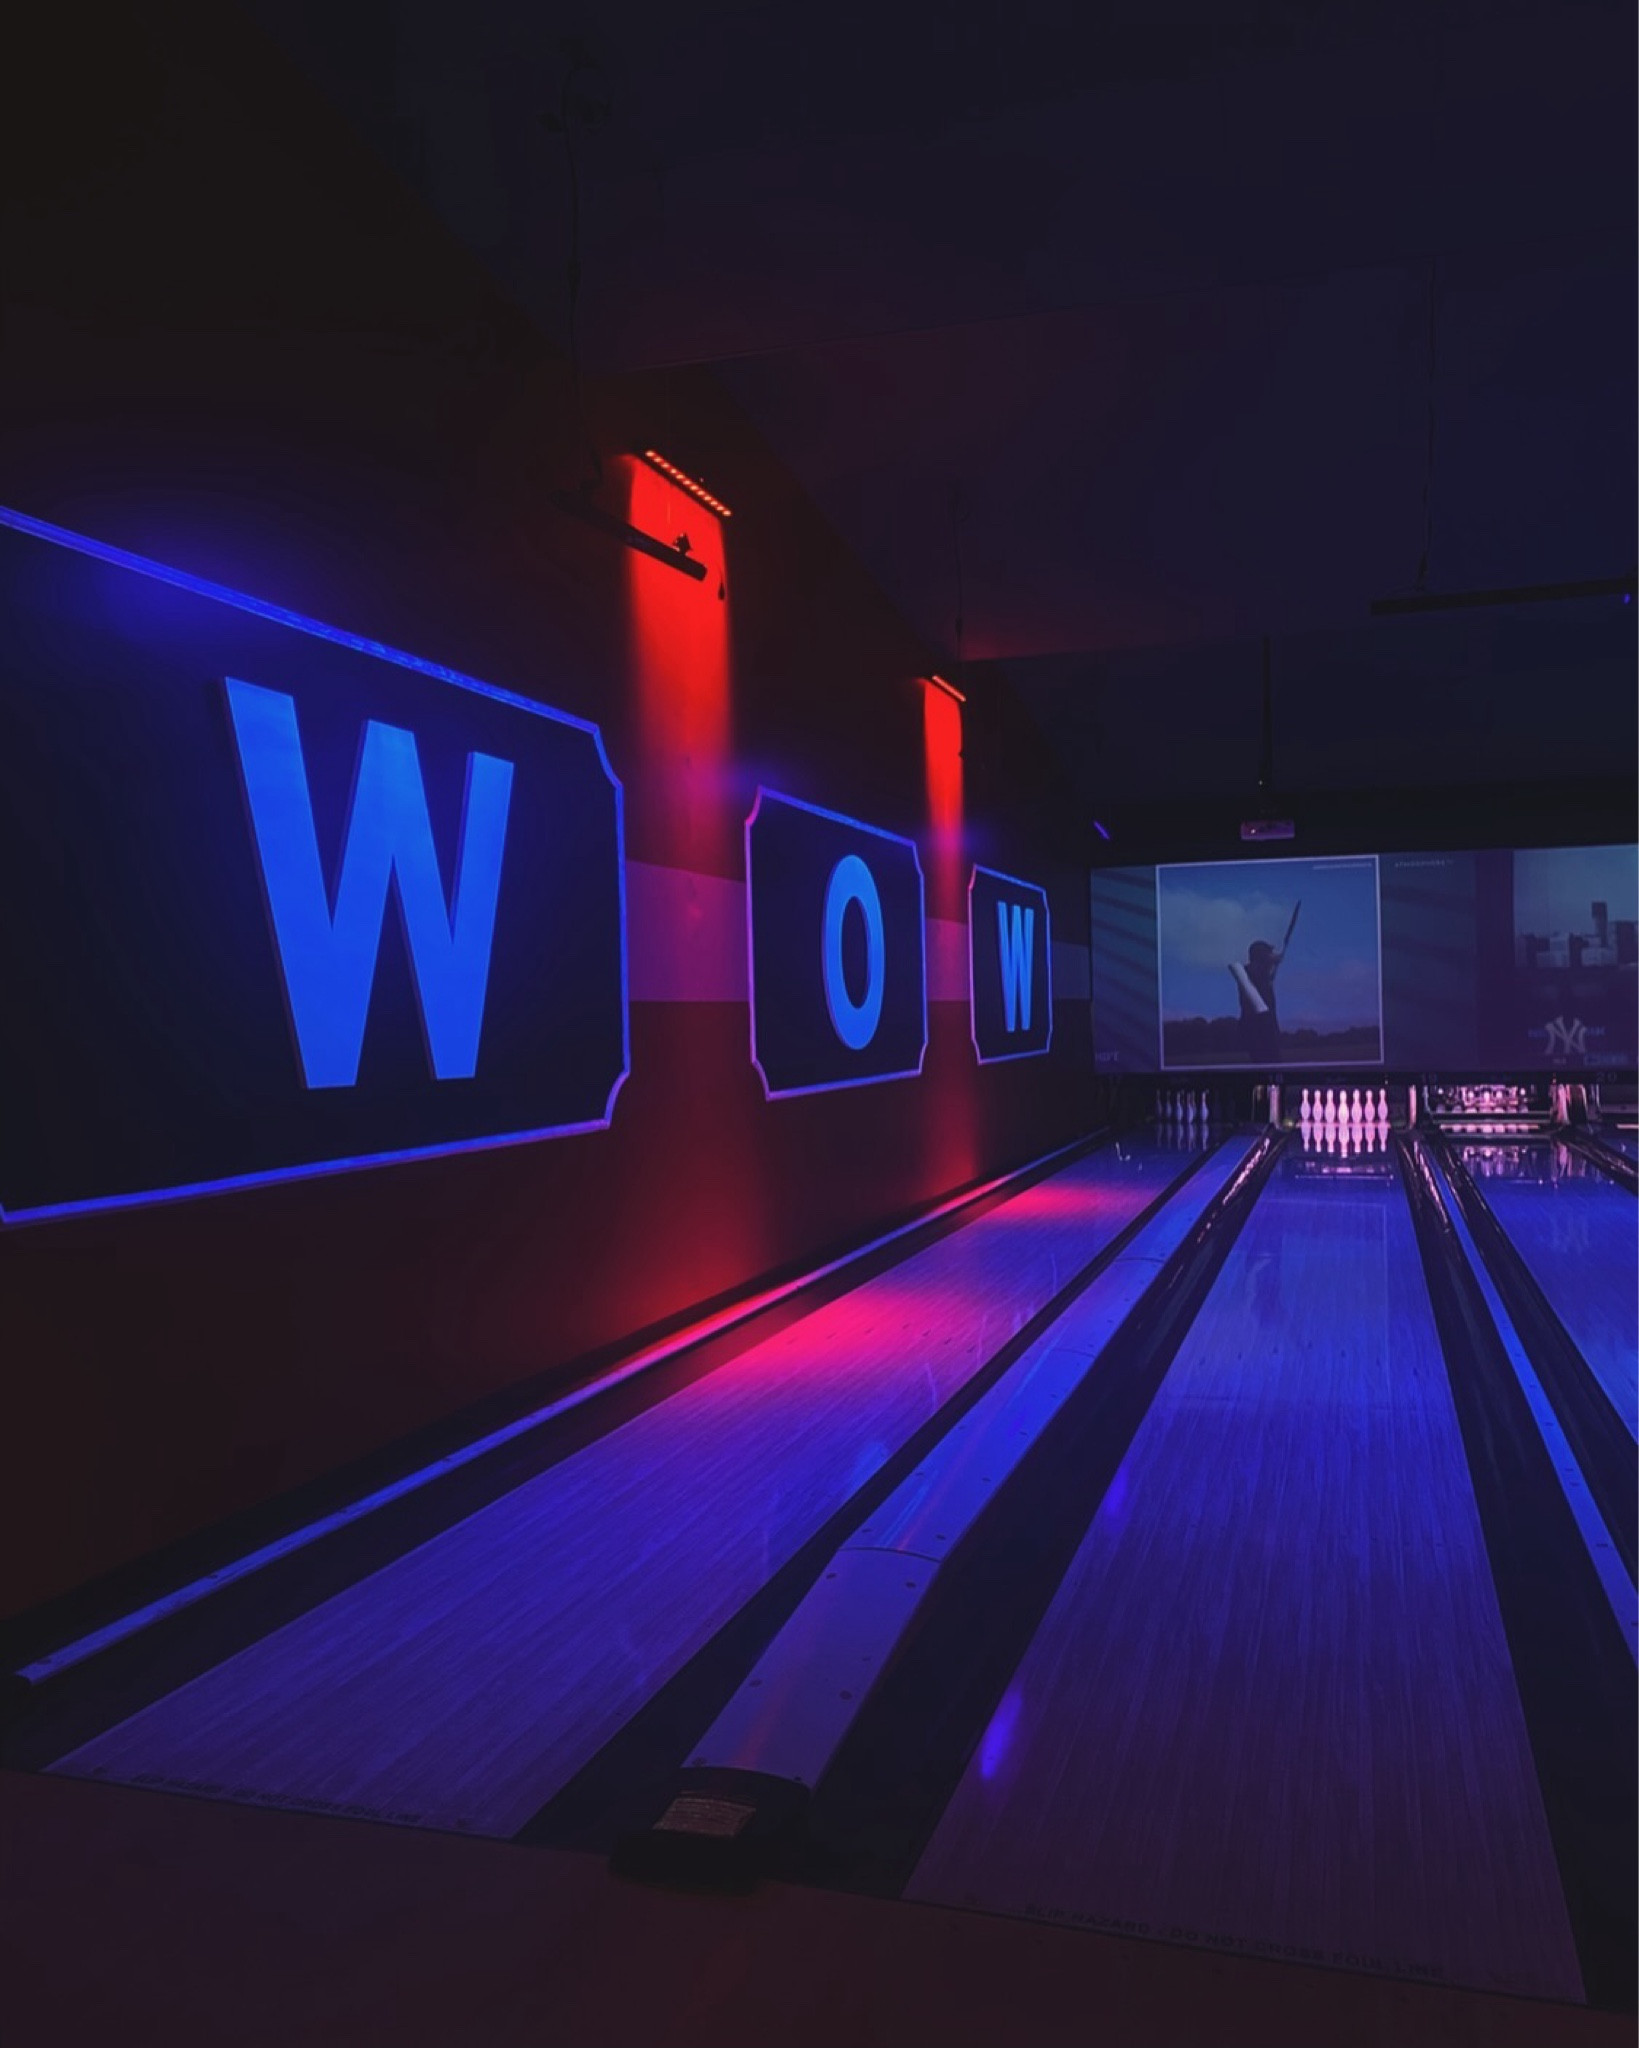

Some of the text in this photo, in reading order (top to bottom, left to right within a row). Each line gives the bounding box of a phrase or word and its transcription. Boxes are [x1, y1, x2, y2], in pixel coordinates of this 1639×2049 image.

[225, 676, 1034, 1090] W O W
[1544, 1015, 1588, 1055] NY
[1072, 1911, 1150, 1934] HAZARD
[1170, 1927, 1199, 1942] DO
[1206, 1934, 1248, 1951] NOT
[1256, 1939, 1325, 1960] CROSS
[1332, 1950, 1384, 1969] FOUL
